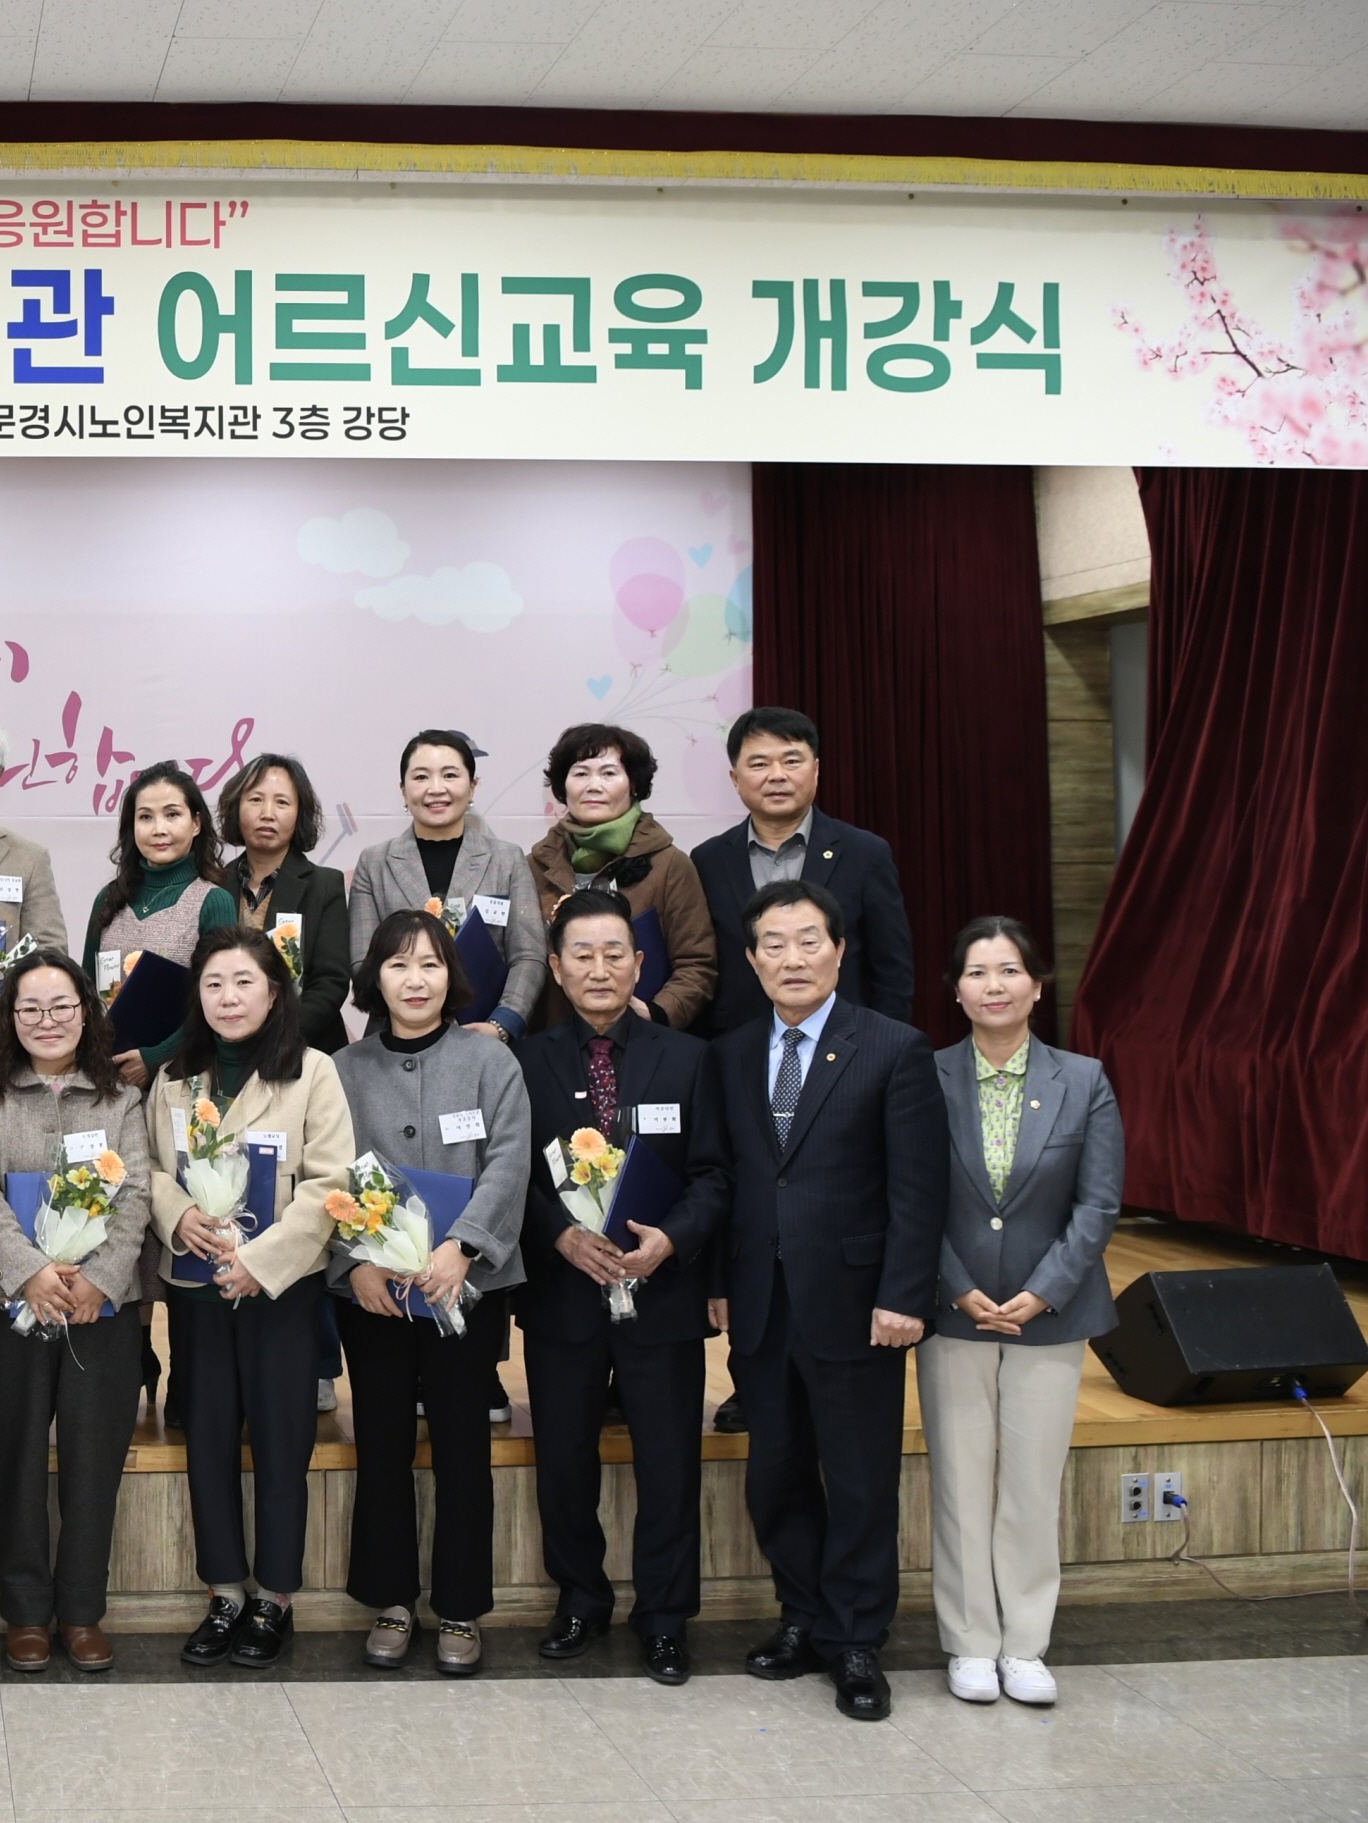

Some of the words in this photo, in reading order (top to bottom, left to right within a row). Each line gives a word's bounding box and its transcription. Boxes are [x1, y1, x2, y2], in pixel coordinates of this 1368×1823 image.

[158, 270, 709, 390] 어르신교육
[752, 278, 1063, 395] 개강식
[272, 404, 331, 440] 3층
[343, 406, 411, 441] 강당
